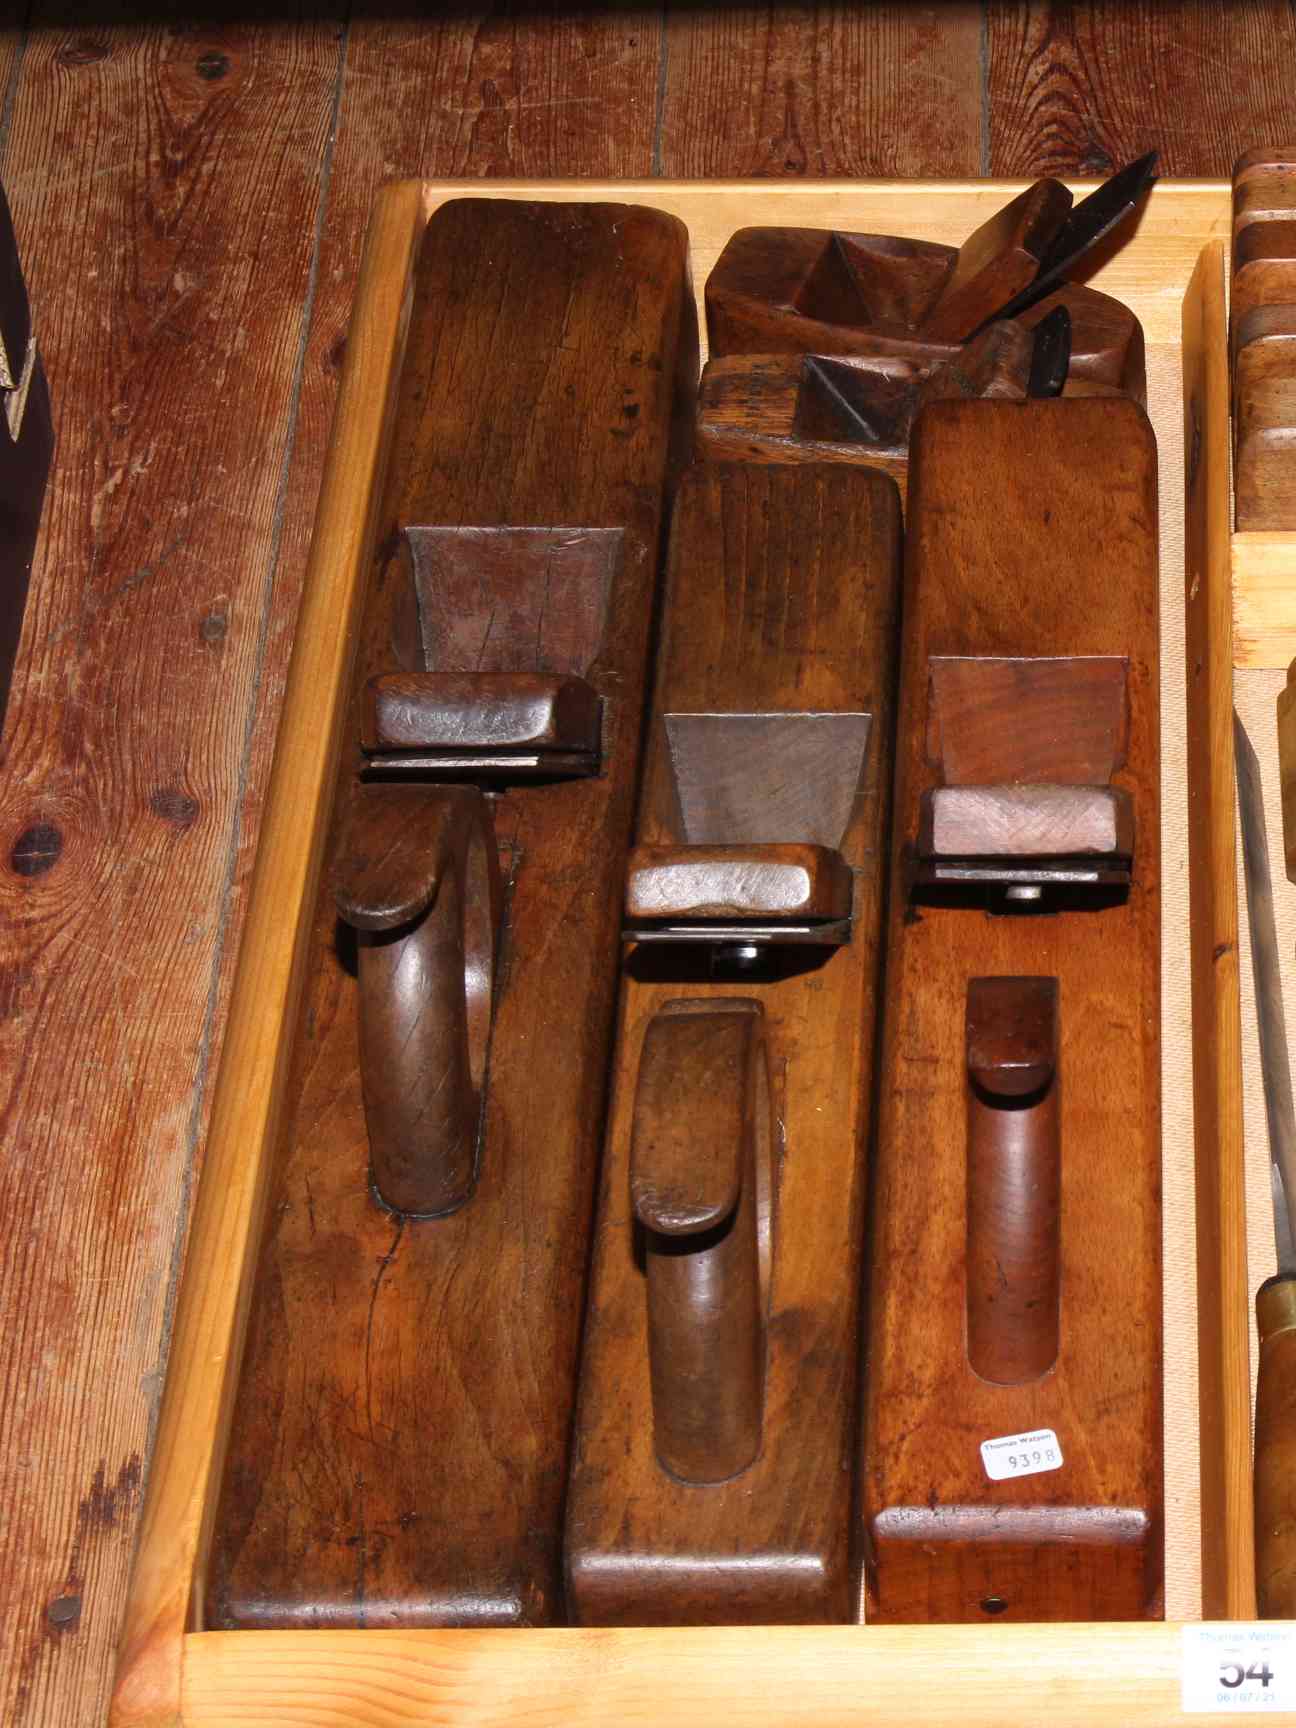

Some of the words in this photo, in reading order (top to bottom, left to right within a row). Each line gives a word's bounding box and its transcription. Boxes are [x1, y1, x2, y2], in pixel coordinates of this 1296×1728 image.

[984, 1441, 1017, 1451] Thomas
[1018, 1434, 1051, 1443] Watson
[1008, 1449, 1055, 1469] 9398
[1219, 1651, 1274, 1688] 54
